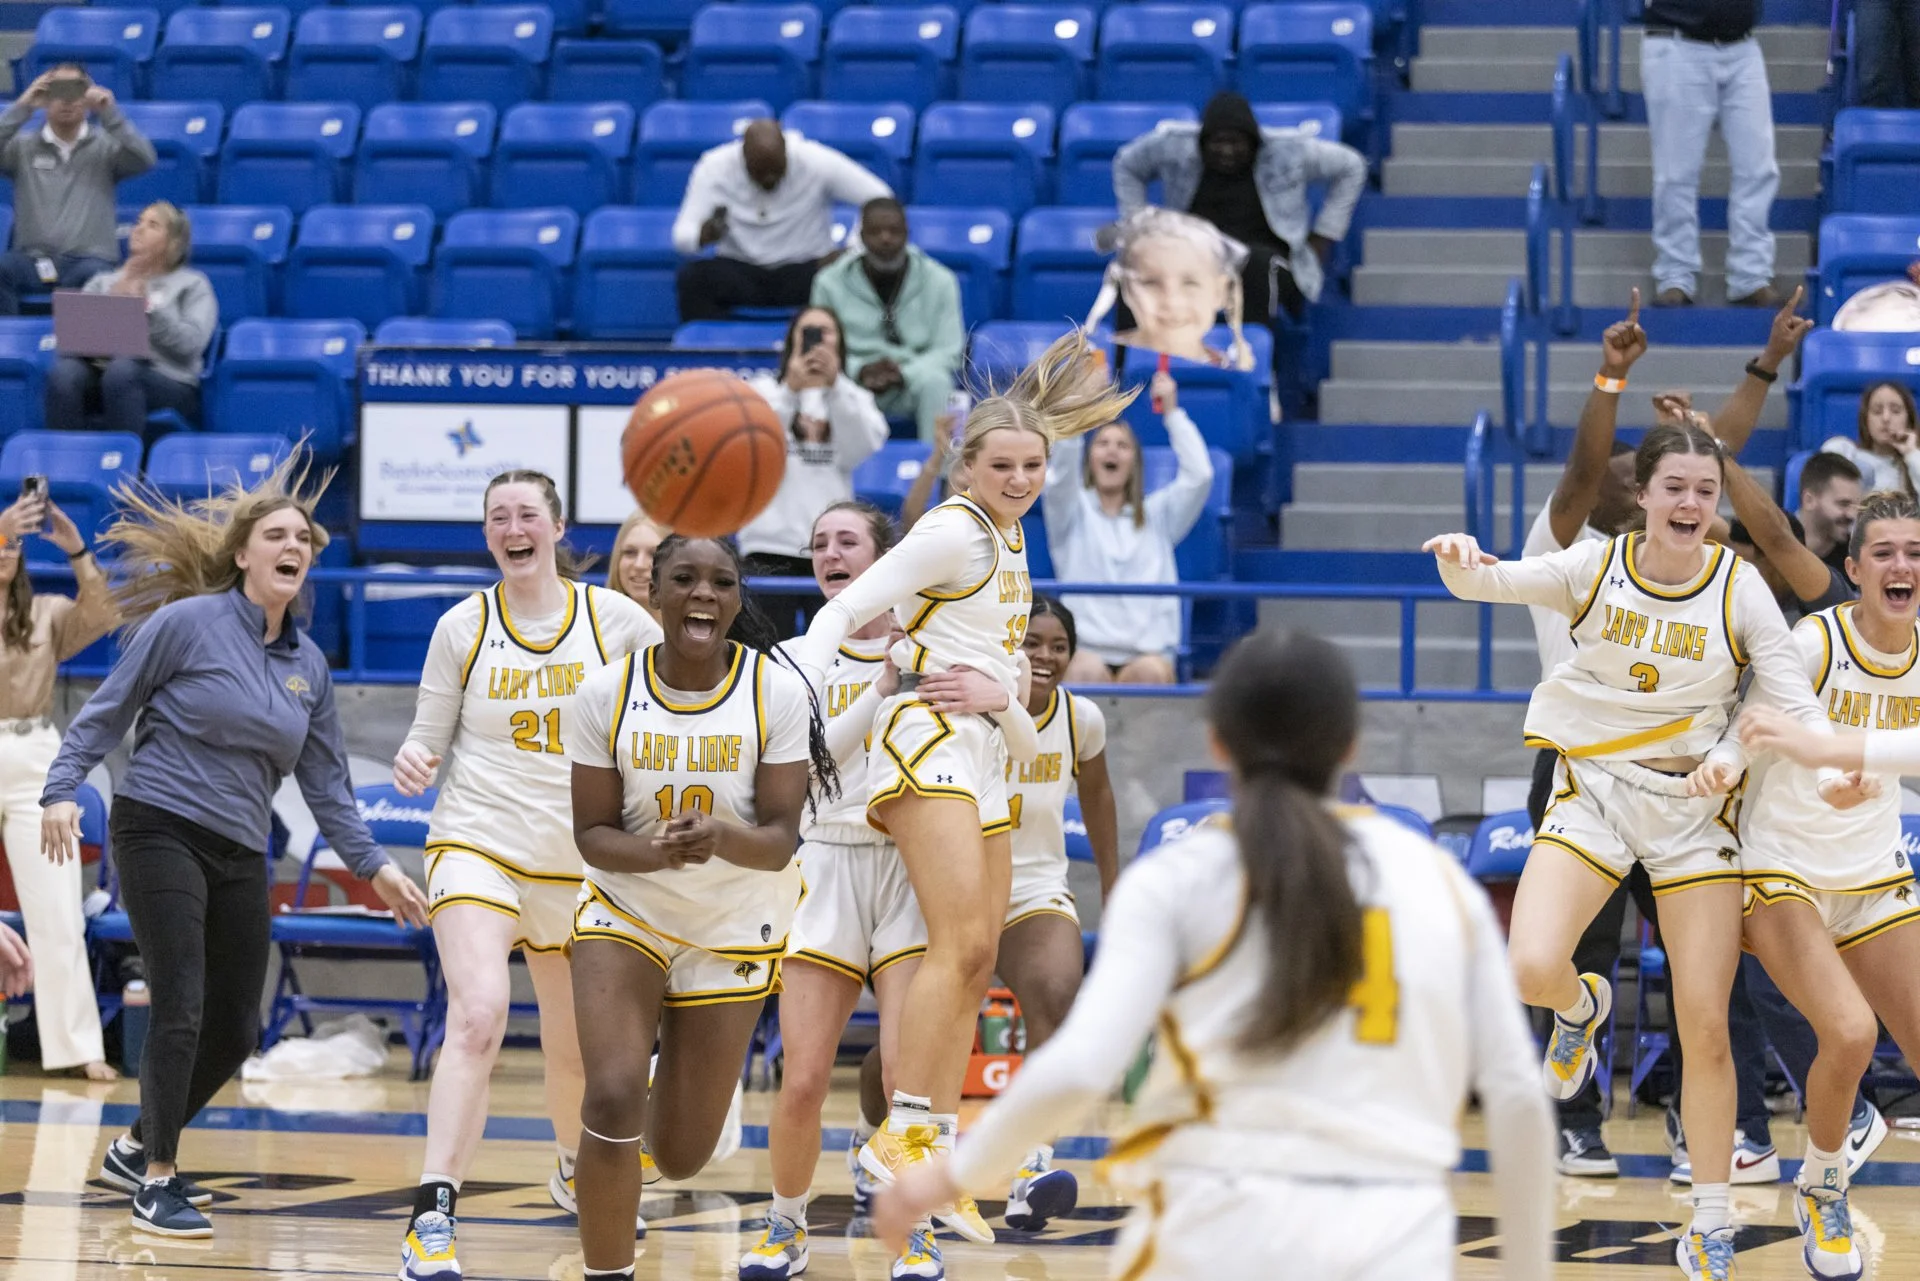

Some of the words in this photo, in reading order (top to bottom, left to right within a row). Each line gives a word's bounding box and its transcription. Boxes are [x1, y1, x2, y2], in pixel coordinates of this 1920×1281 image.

[367, 362, 452, 387] THANK
[458, 364, 515, 389] YOU
[521, 365, 577, 389] FOR
[583, 365, 657, 390] YOUR
[1601, 604, 1649, 649] LADY
[1651, 618, 1709, 662] LIONS
[487, 666, 533, 700] LADY
[536, 661, 585, 698] LIONS
[1629, 661, 1660, 693] 3
[1828, 687, 1872, 728] LADY
[1876, 694, 1920, 730] LIONS
[510, 707, 565, 755] 21
[632, 731, 679, 772] LADY
[687, 734, 742, 772] LIONS
[655, 784, 714, 823] 10
[982, 1060, 1010, 1092] G
